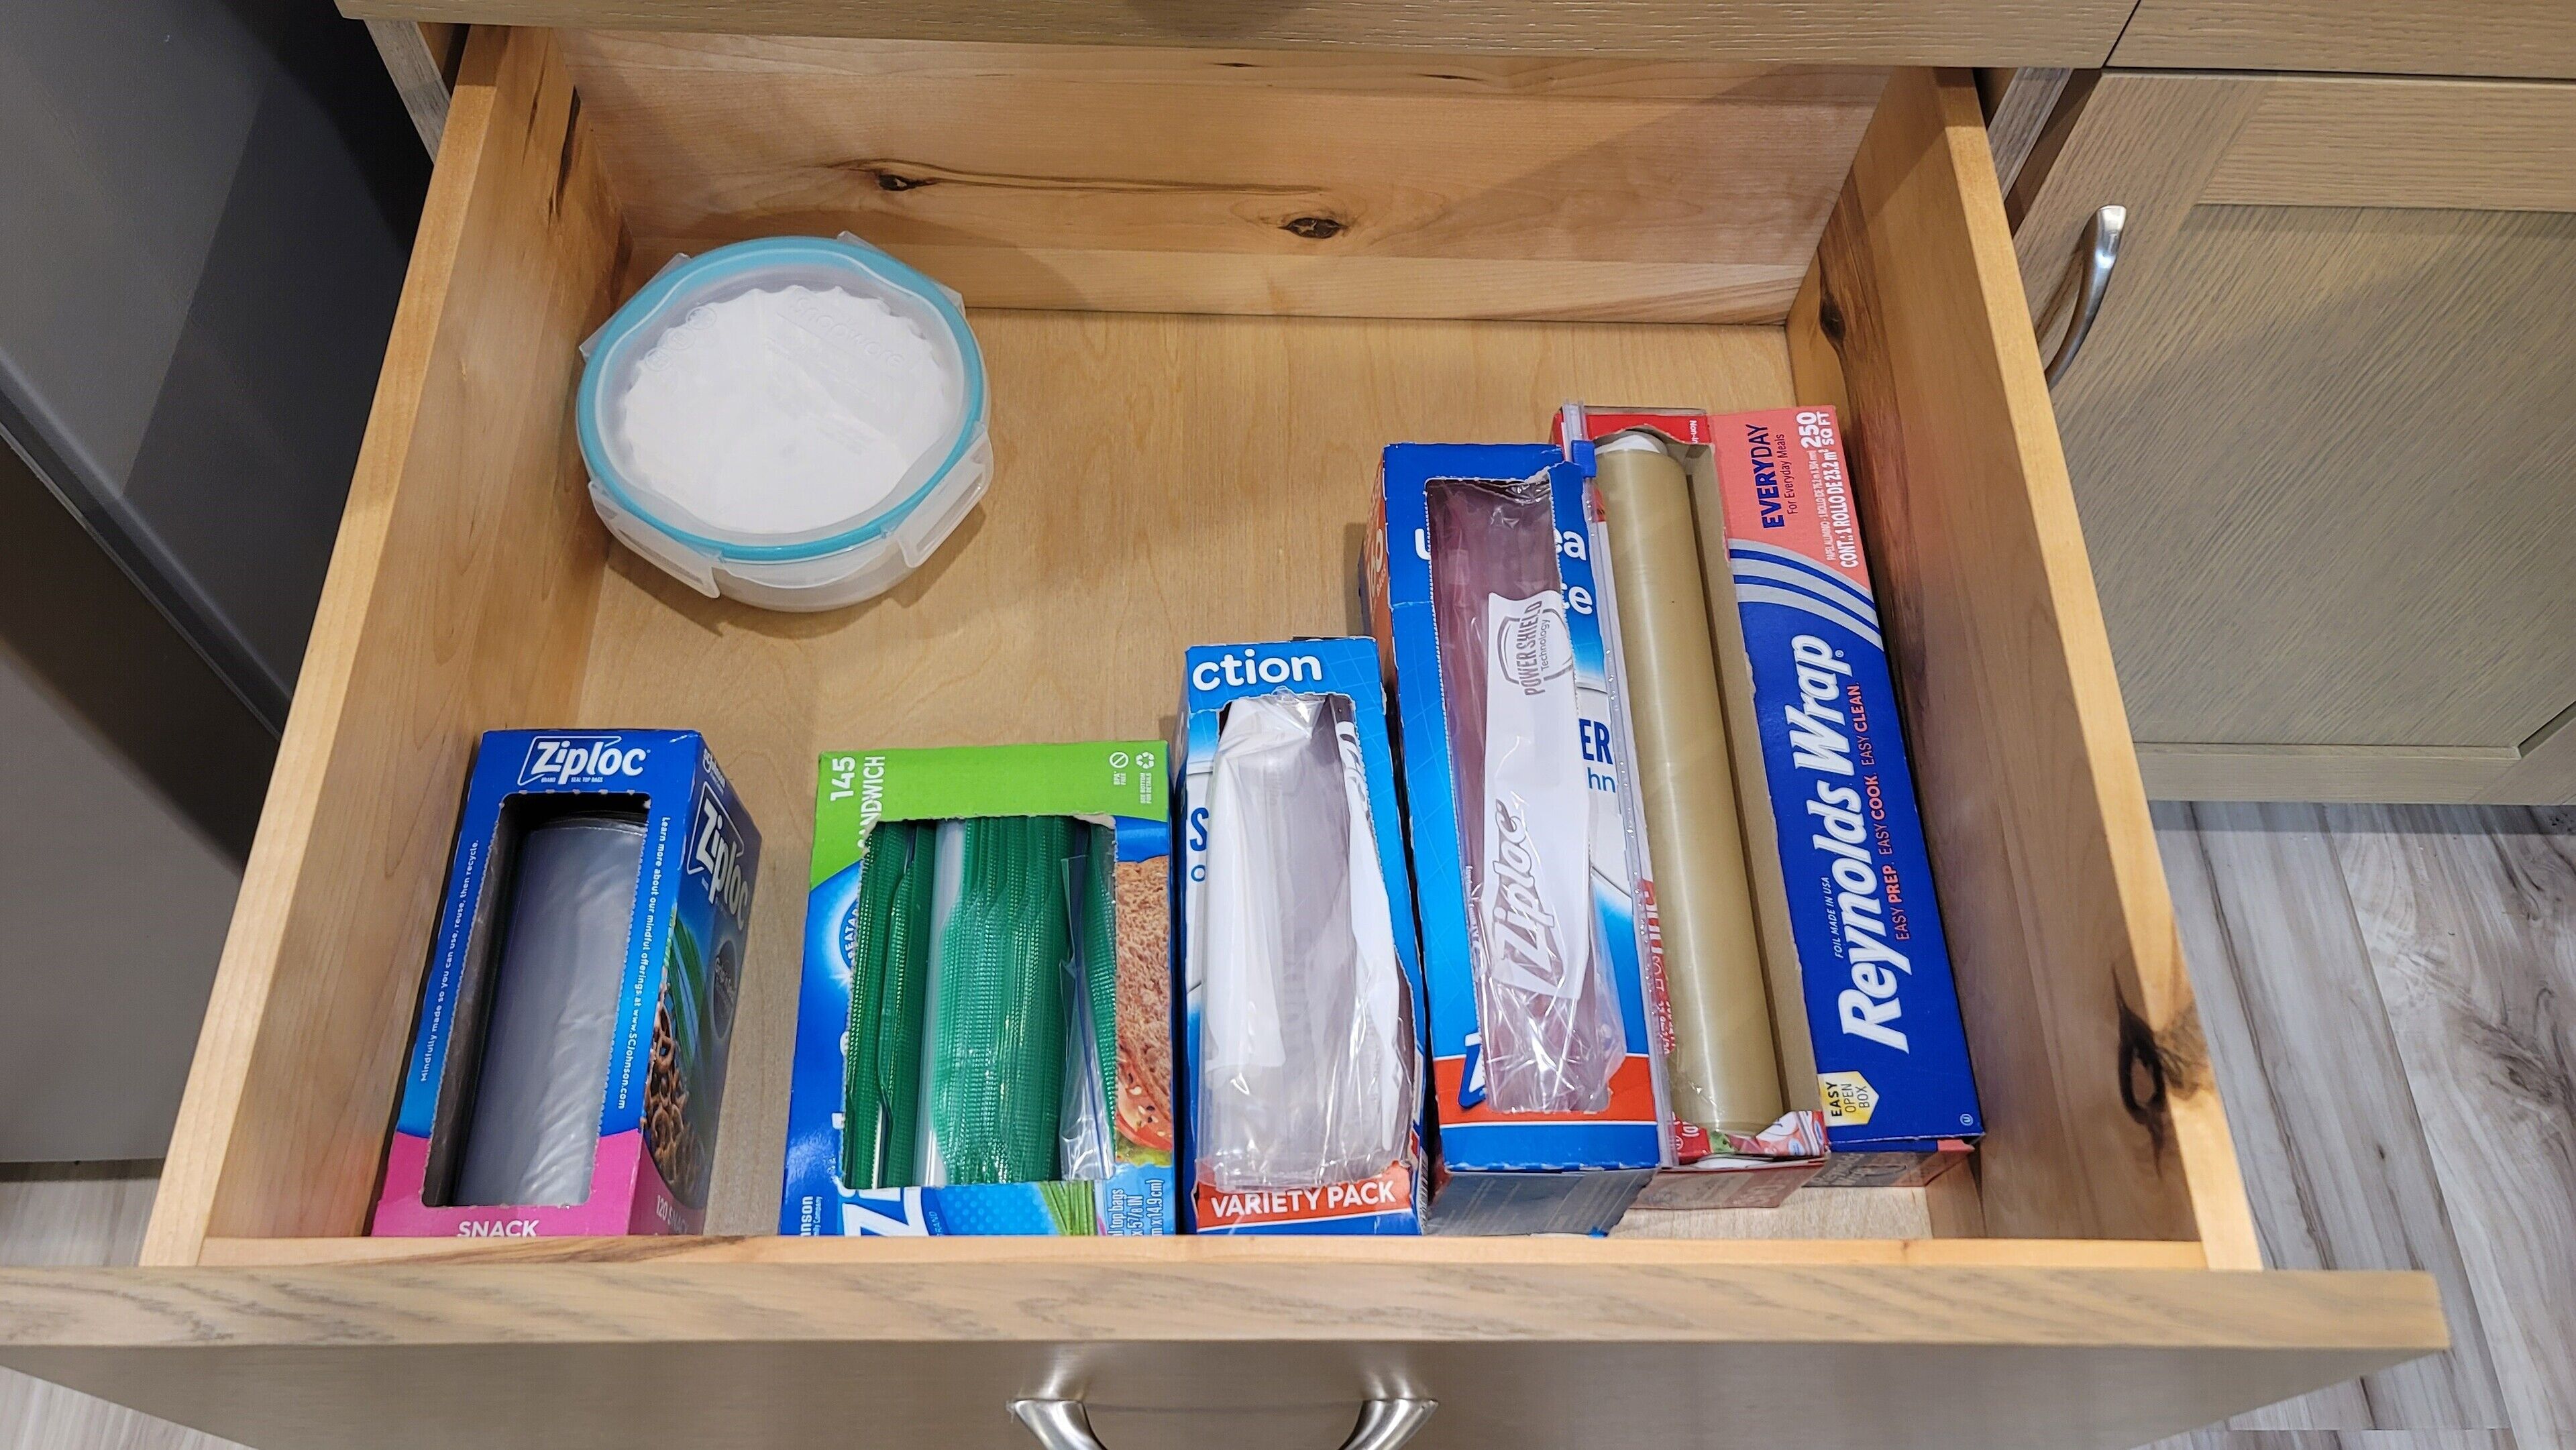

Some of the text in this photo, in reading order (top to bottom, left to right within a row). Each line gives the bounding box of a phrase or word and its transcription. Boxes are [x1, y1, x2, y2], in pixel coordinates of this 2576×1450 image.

[1796, 411, 1822, 449] 250
[1816, 411, 1835, 445] SQ FT
[1746, 424, 1784, 528] EVERYDAY
[1774, 433, 1798, 514] For Everyday Meals
[1825, 481, 1845, 494] DE
[1828, 495, 1851, 526] ROLLO
[1835, 526, 1852, 535] 1
[1516, 600, 1546, 695] POWER SHIELD
[1541, 618, 1550, 670] Technology
[531, 740, 647, 785] Ziploc
[830, 757, 856, 801] 145
[857, 756, 885, 848] NDWICH
[1847, 681, 1911, 941] EASY PREP. EASY COOK. EASY CLEAN.
[466, 840, 479, 875] recycle.
[696, 797, 749, 931] Ziploc
[460, 877, 470, 899] then
[1806, 779, 1912, 1054] Reynolds
[1821, 877, 1844, 959] FOIL MADE IN USA
[445, 951, 454, 968] can
[618, 816, 671, 1110] Learn more about our mindful offerings at www.SCJohnson.com
[438, 991, 445, 1003] so
[441, 971, 449, 988] you
[432, 1005, 443, 1032] made
[421, 1034, 438, 1082] Mindfully
[1825, 1081, 1843, 1117] EASY
[1841, 1082, 1856, 1113] OPEN
[1856, 1085, 1870, 1109] BOX
[655, 1194, 668, 1221] 120
[1108, 1188, 1128, 1212] bags
[1127, 1195, 1143, 1206] IN
[1210, 1180, 1396, 1219] VARIETY PACK
[458, 1219, 540, 1237] SNACK
[1109, 1213, 1127, 1229] top
